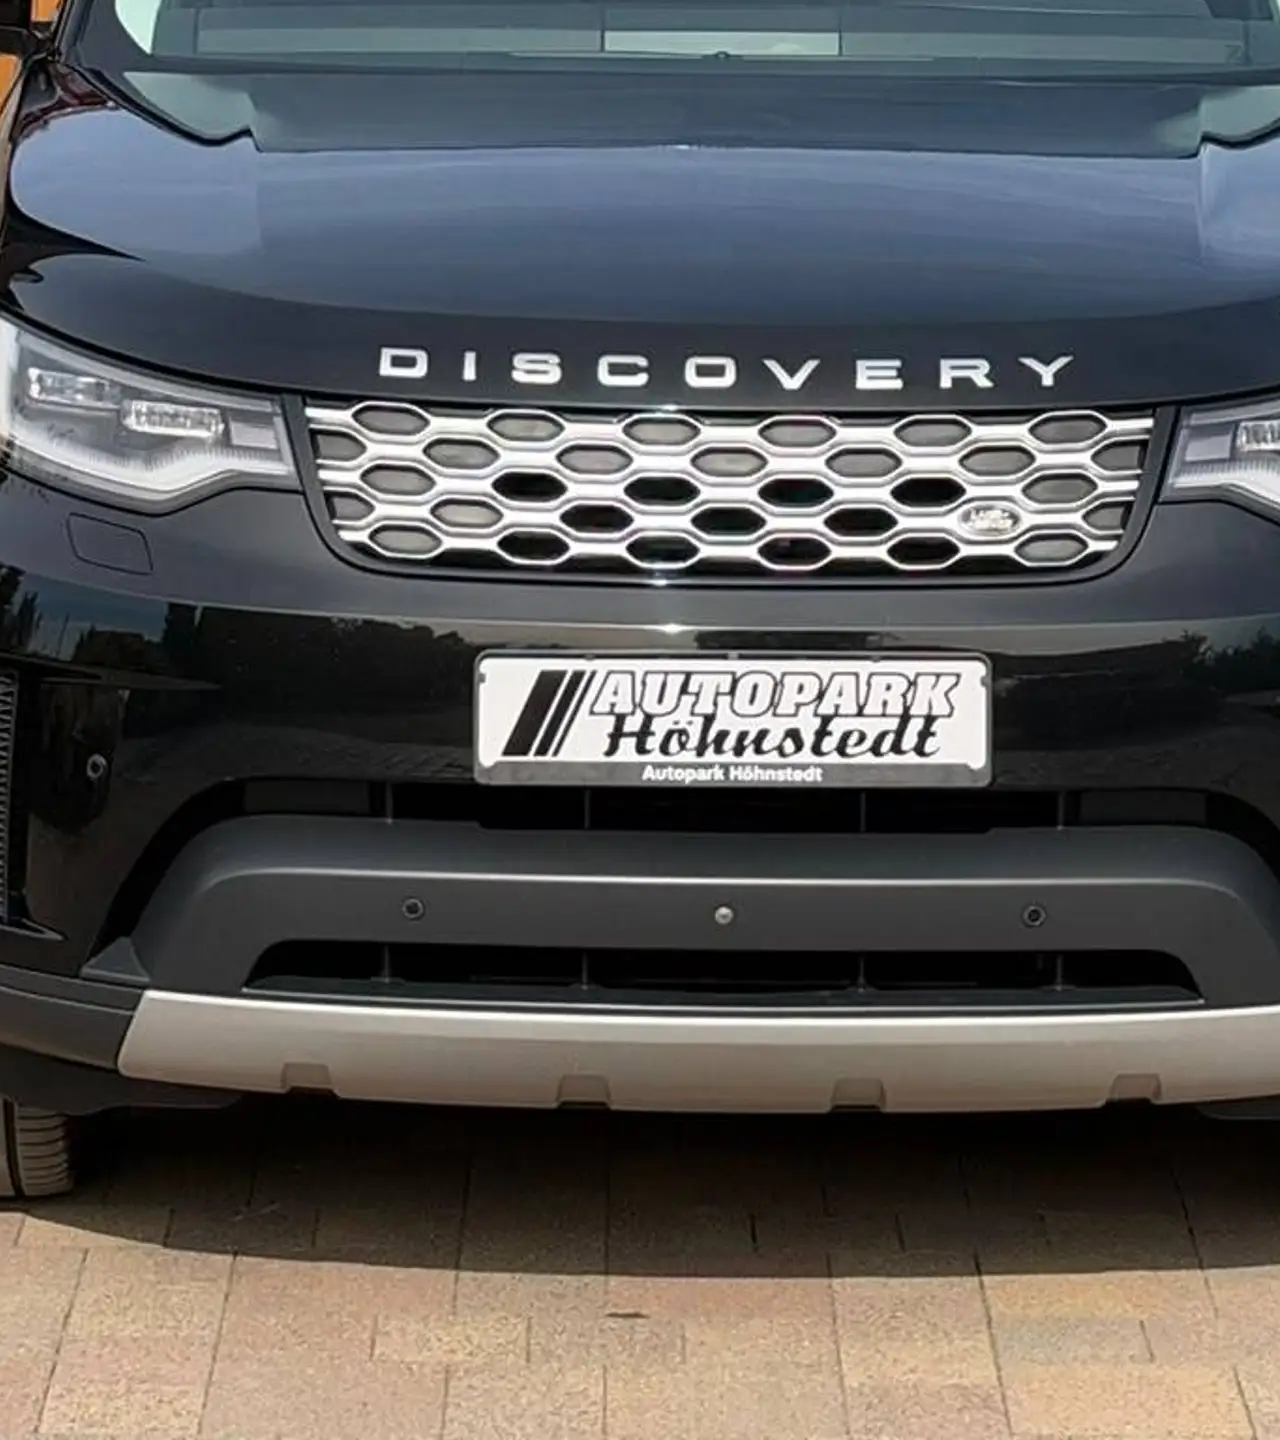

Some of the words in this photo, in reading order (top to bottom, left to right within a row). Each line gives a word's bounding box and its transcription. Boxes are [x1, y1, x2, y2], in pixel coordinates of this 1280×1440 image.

[379, 347, 1074, 390] DISCOVERY
[589, 670, 963, 718] AUTOPARK
[604, 711, 941, 758] Höhnstedt
[642, 764, 725, 784] Autopark
[729, 765, 823, 782] Höhnstedt
